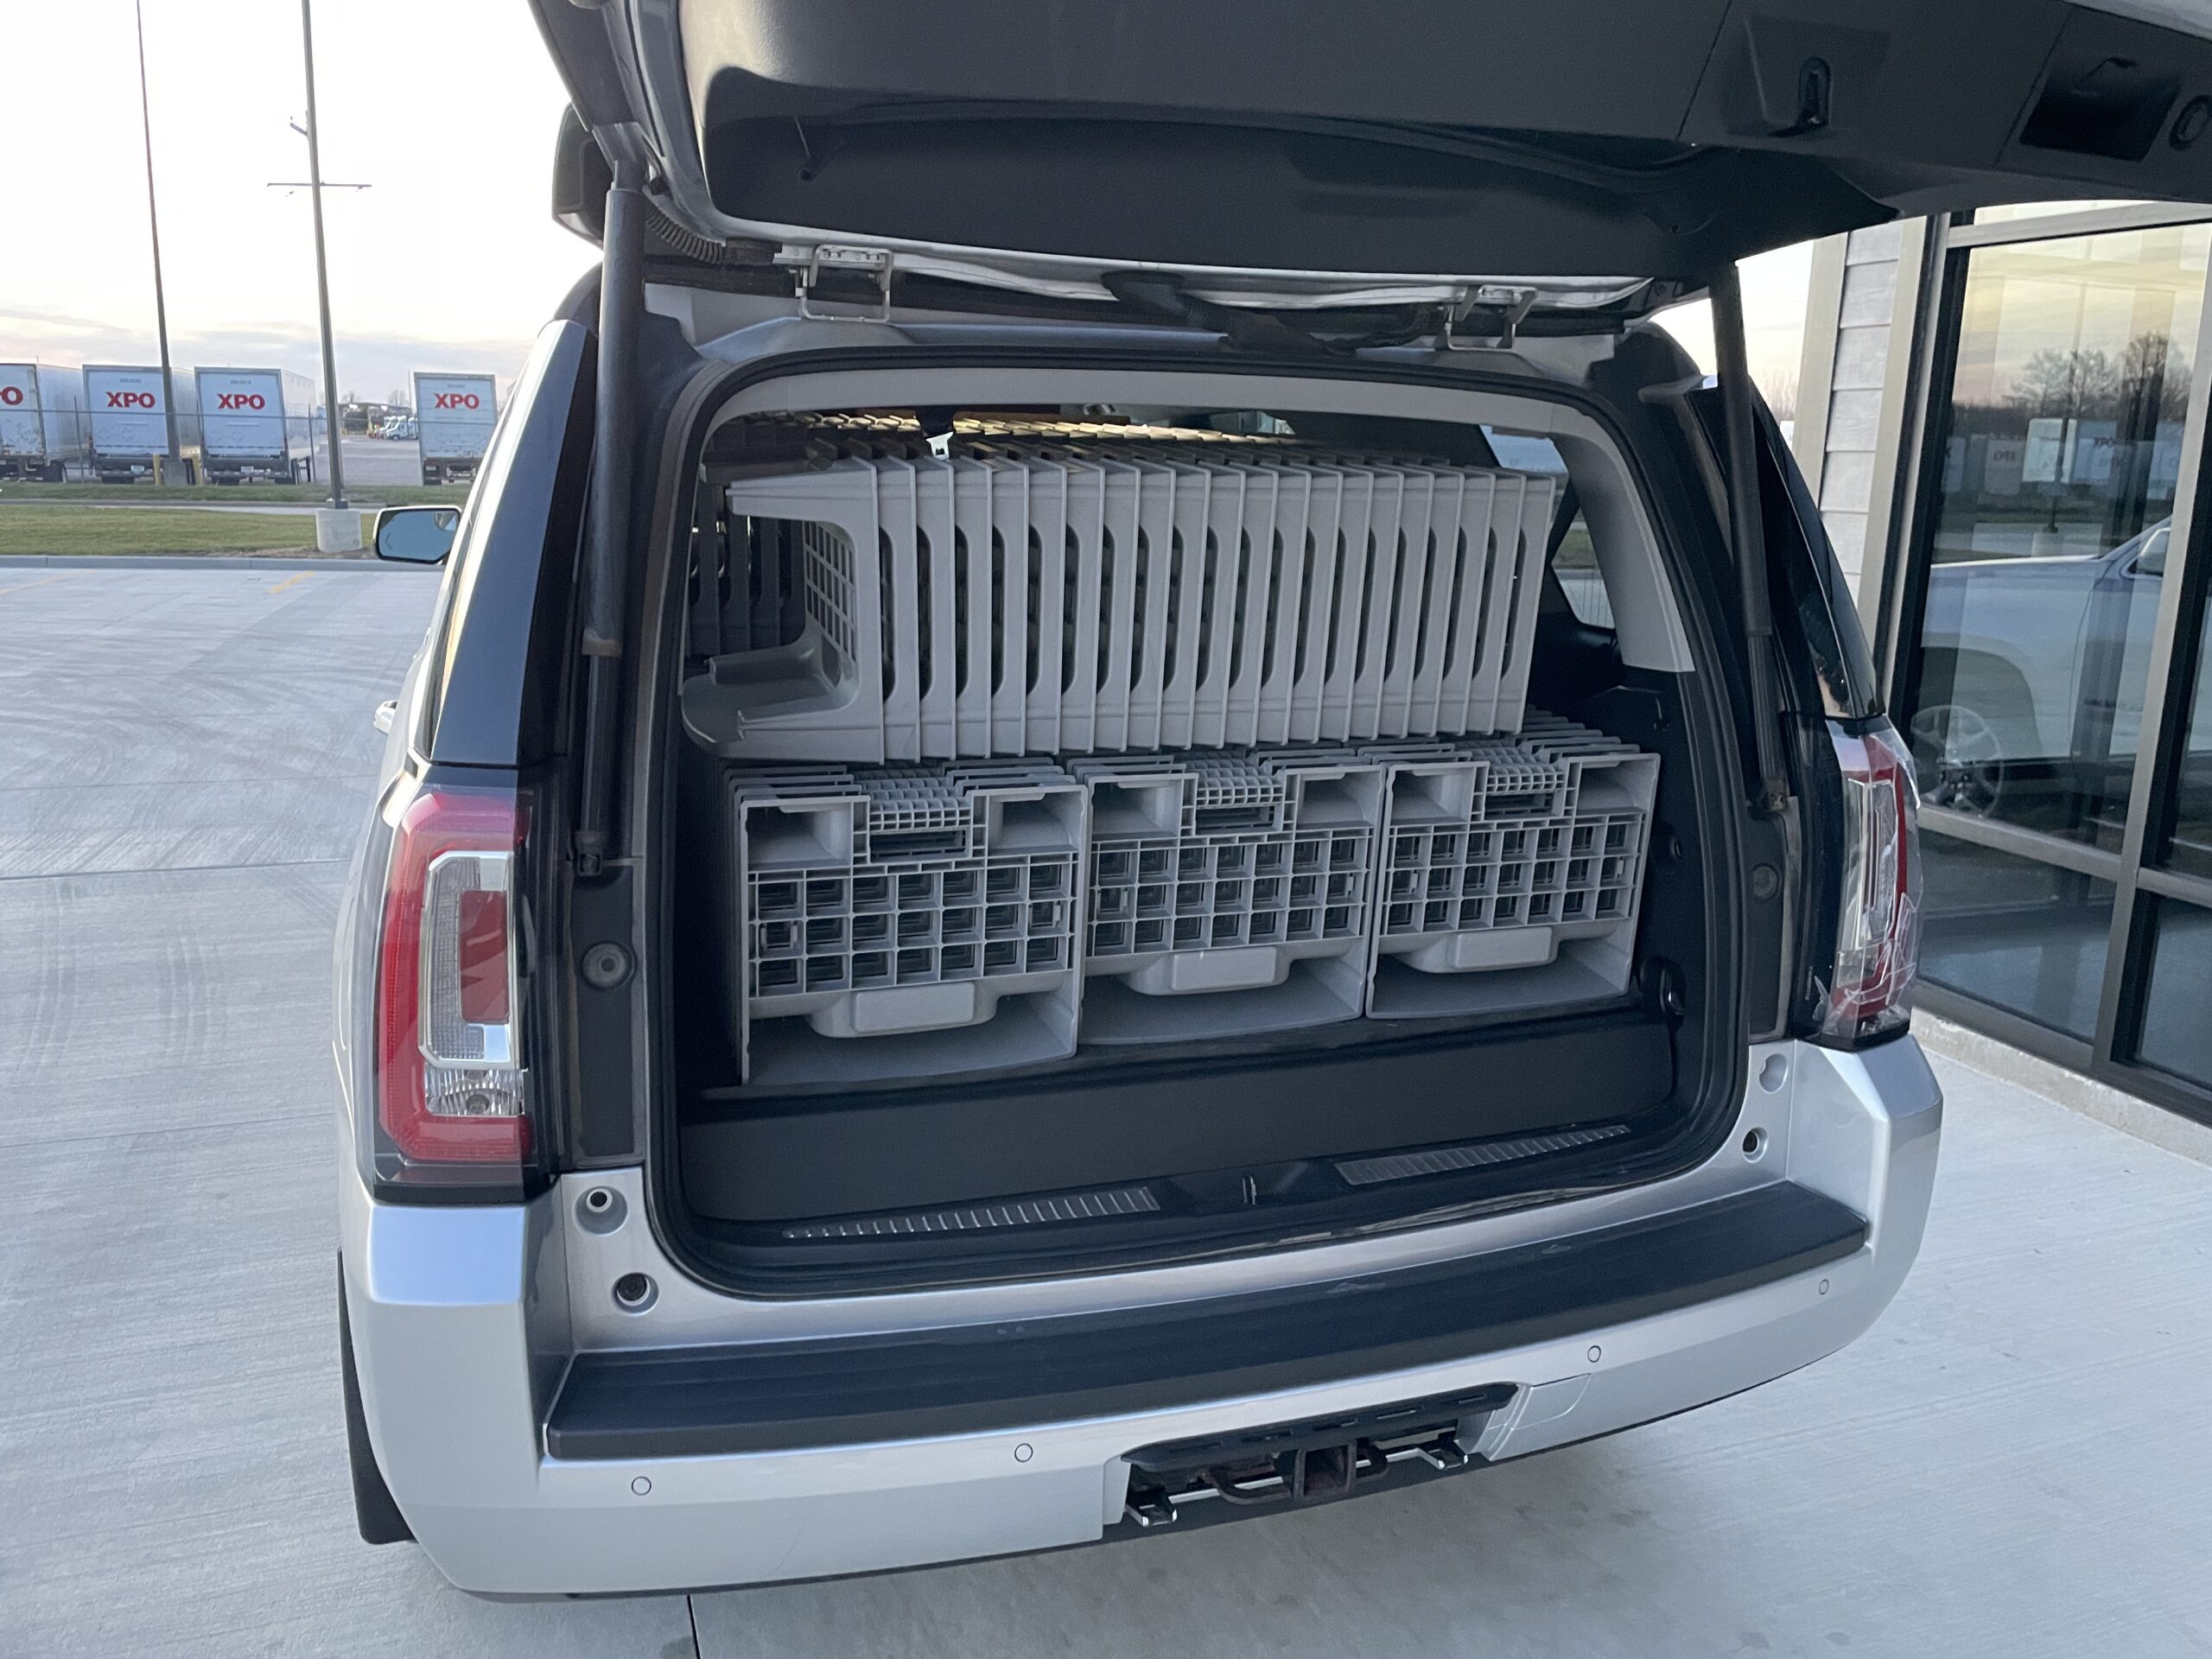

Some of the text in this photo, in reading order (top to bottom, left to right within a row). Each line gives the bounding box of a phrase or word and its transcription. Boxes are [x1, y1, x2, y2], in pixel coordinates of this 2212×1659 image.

[105, 392, 156, 409] XPO
[216, 393, 265, 410] XPO
[434, 393, 480, 410] XPO
